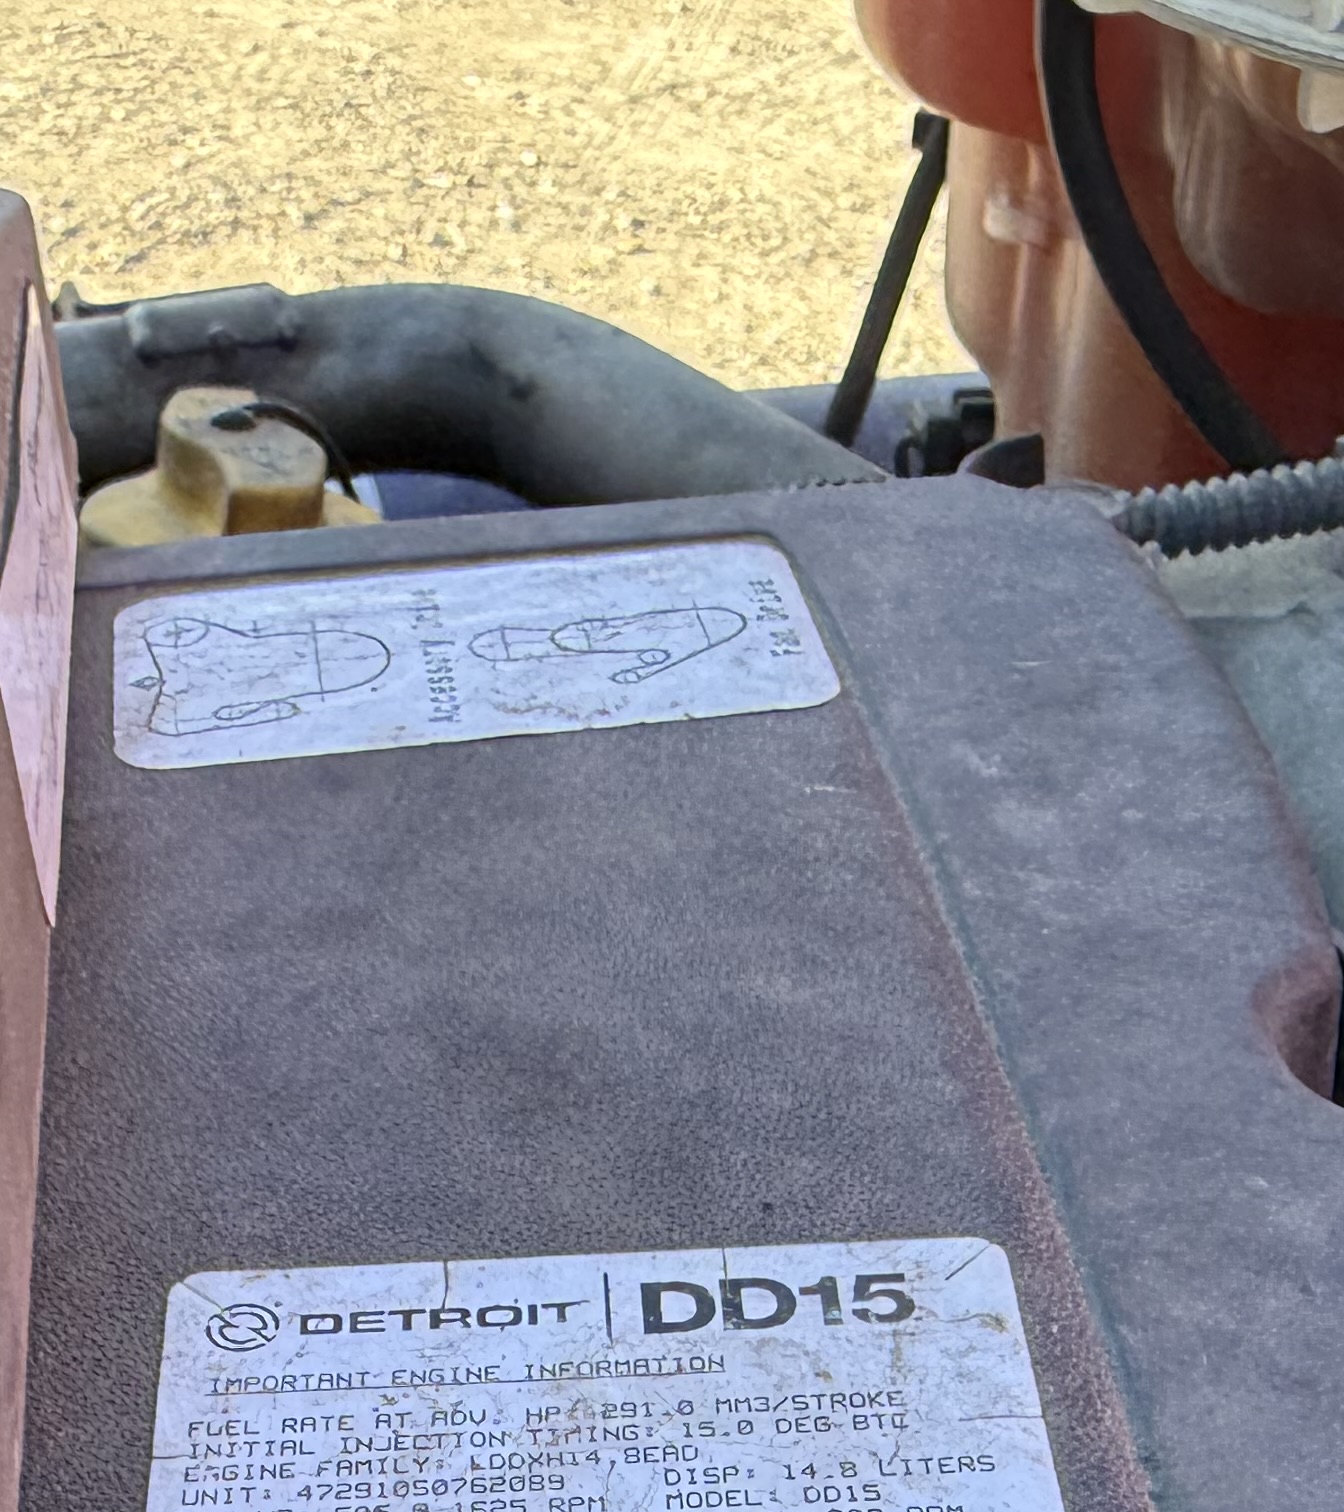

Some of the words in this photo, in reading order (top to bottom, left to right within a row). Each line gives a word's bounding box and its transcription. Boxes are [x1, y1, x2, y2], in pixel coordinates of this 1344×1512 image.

[299, 1300, 590, 1335] DETROIT
[640, 1273, 916, 1334] DD15
[210, 1371, 371, 1393] IMPORTANT
[391, 1365, 500, 1386] ENGINE
[524, 1354, 725, 1379] INFORMATION
[188, 1420, 260, 1437] FUEL
[281, 1415, 355, 1433] RATE
[375, 1412, 412, 1429] AT
[716, 1390, 905, 1414] MM3/STROKE
[190, 1440, 315, 1459] INITIAL
[340, 1431, 507, 1454] INJECTION
[683, 1420, 754, 1438] 15.0
[776, 1416, 831, 1434] DEG
[181, 1487, 271, 1505] UNIT:
[664, 1466, 754, 1486] DISP:
[783, 1462, 857, 1480] 14.8
[879, 1455, 996, 1477] LITERS
[184, 1462, 295, 1482] ENGINE
